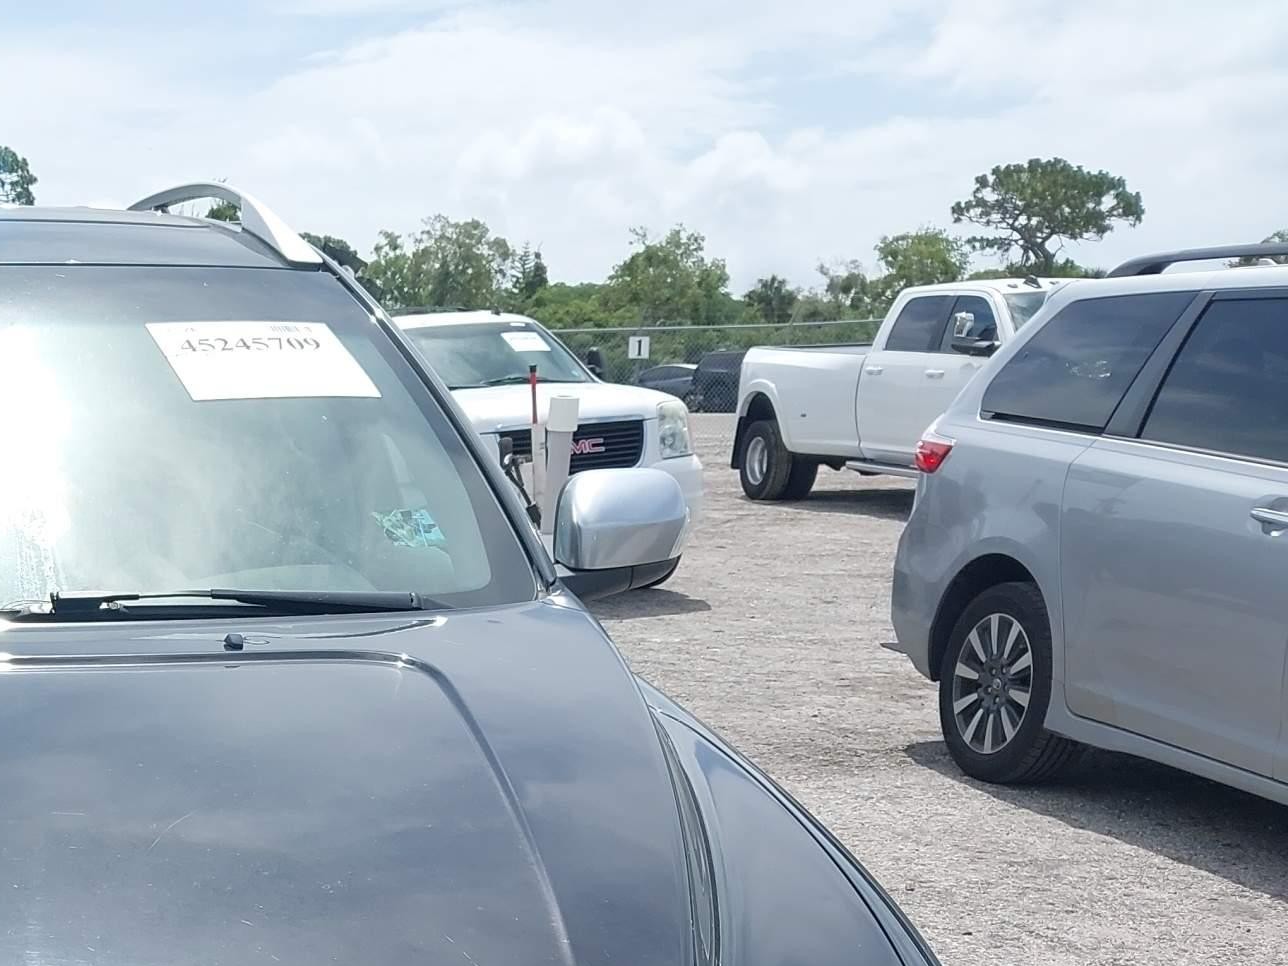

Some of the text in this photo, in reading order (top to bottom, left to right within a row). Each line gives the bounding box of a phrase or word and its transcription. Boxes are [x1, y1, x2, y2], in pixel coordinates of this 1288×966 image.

[181, 337, 321, 352] 45245709
[637, 339, 642, 356] 1
[570, 438, 606, 455] MC
